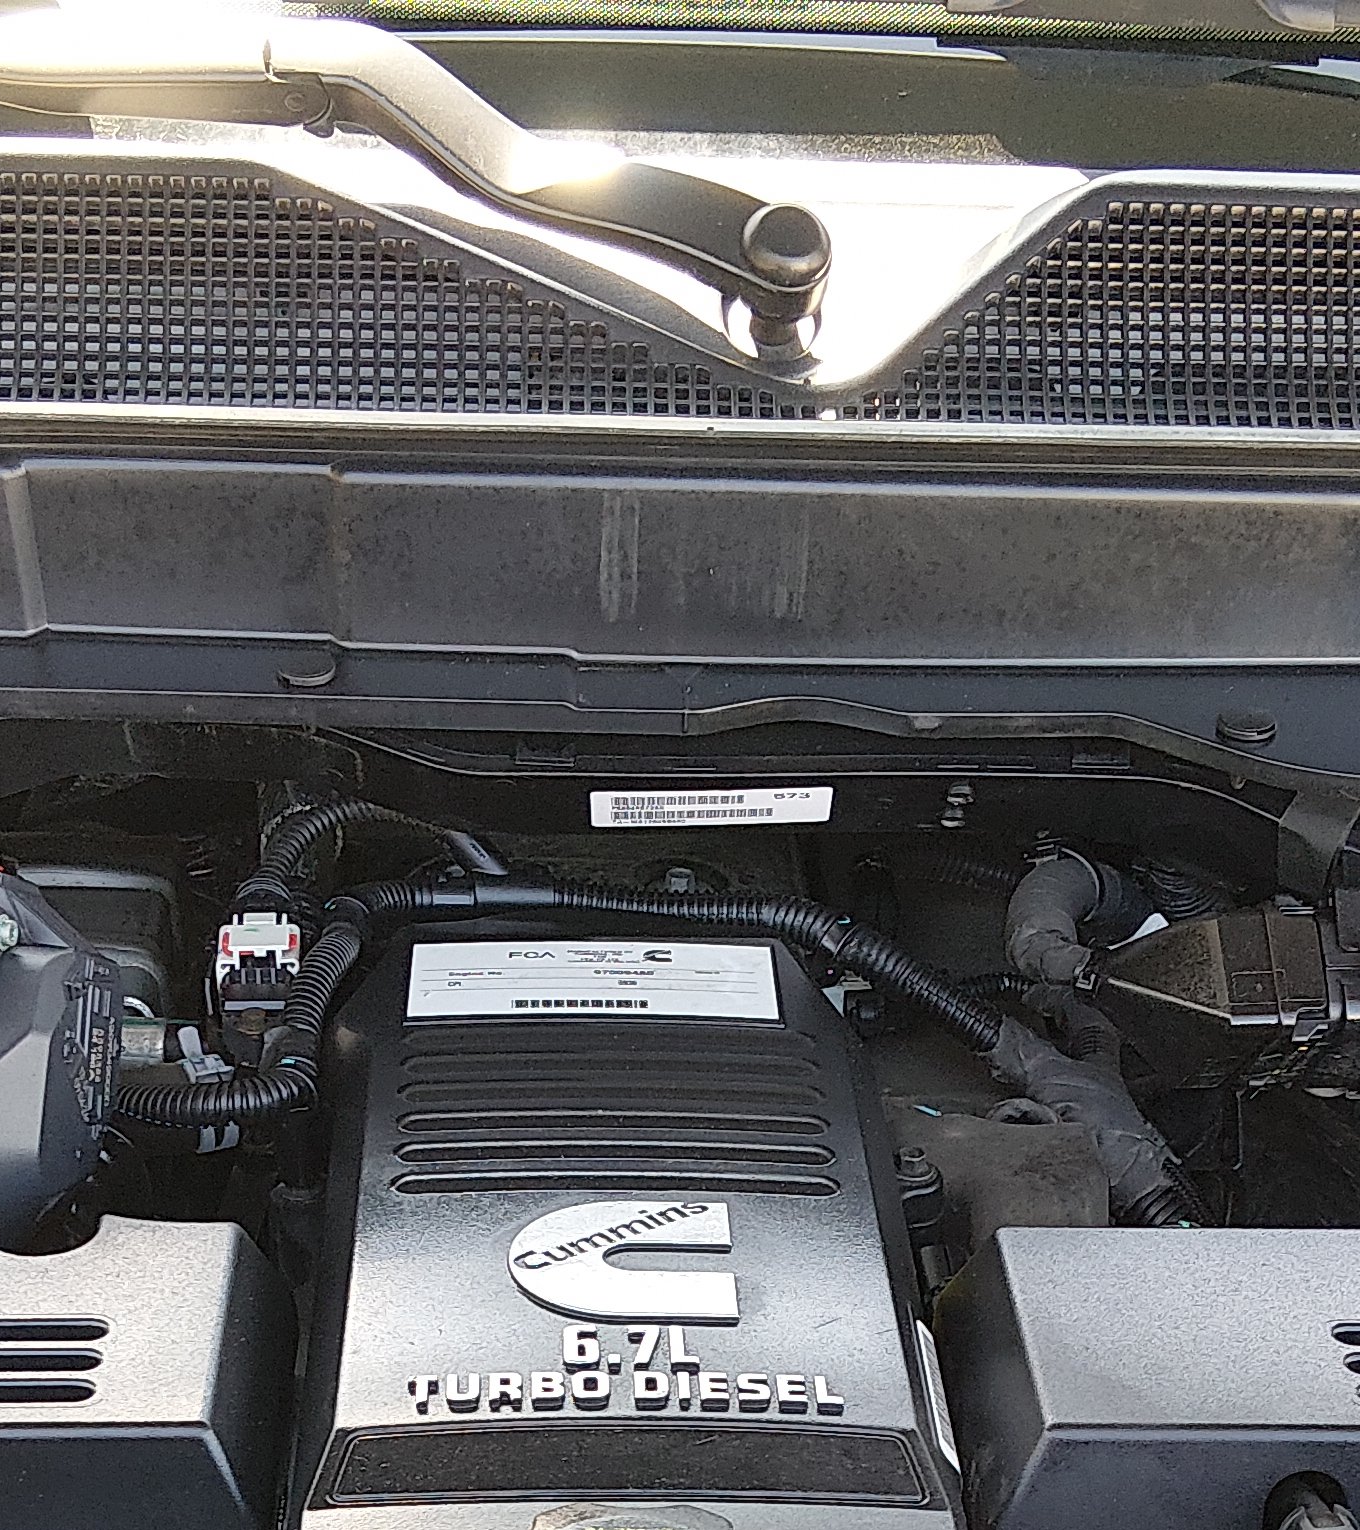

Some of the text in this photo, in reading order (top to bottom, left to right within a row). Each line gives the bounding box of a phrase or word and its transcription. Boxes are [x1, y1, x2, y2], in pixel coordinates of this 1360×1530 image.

[508, 951, 556, 959] FCA
[513, 1202, 710, 1270] Cummins
[561, 1323, 701, 1372] 6.7L
[407, 1370, 846, 1414] TURBO DIESEL
